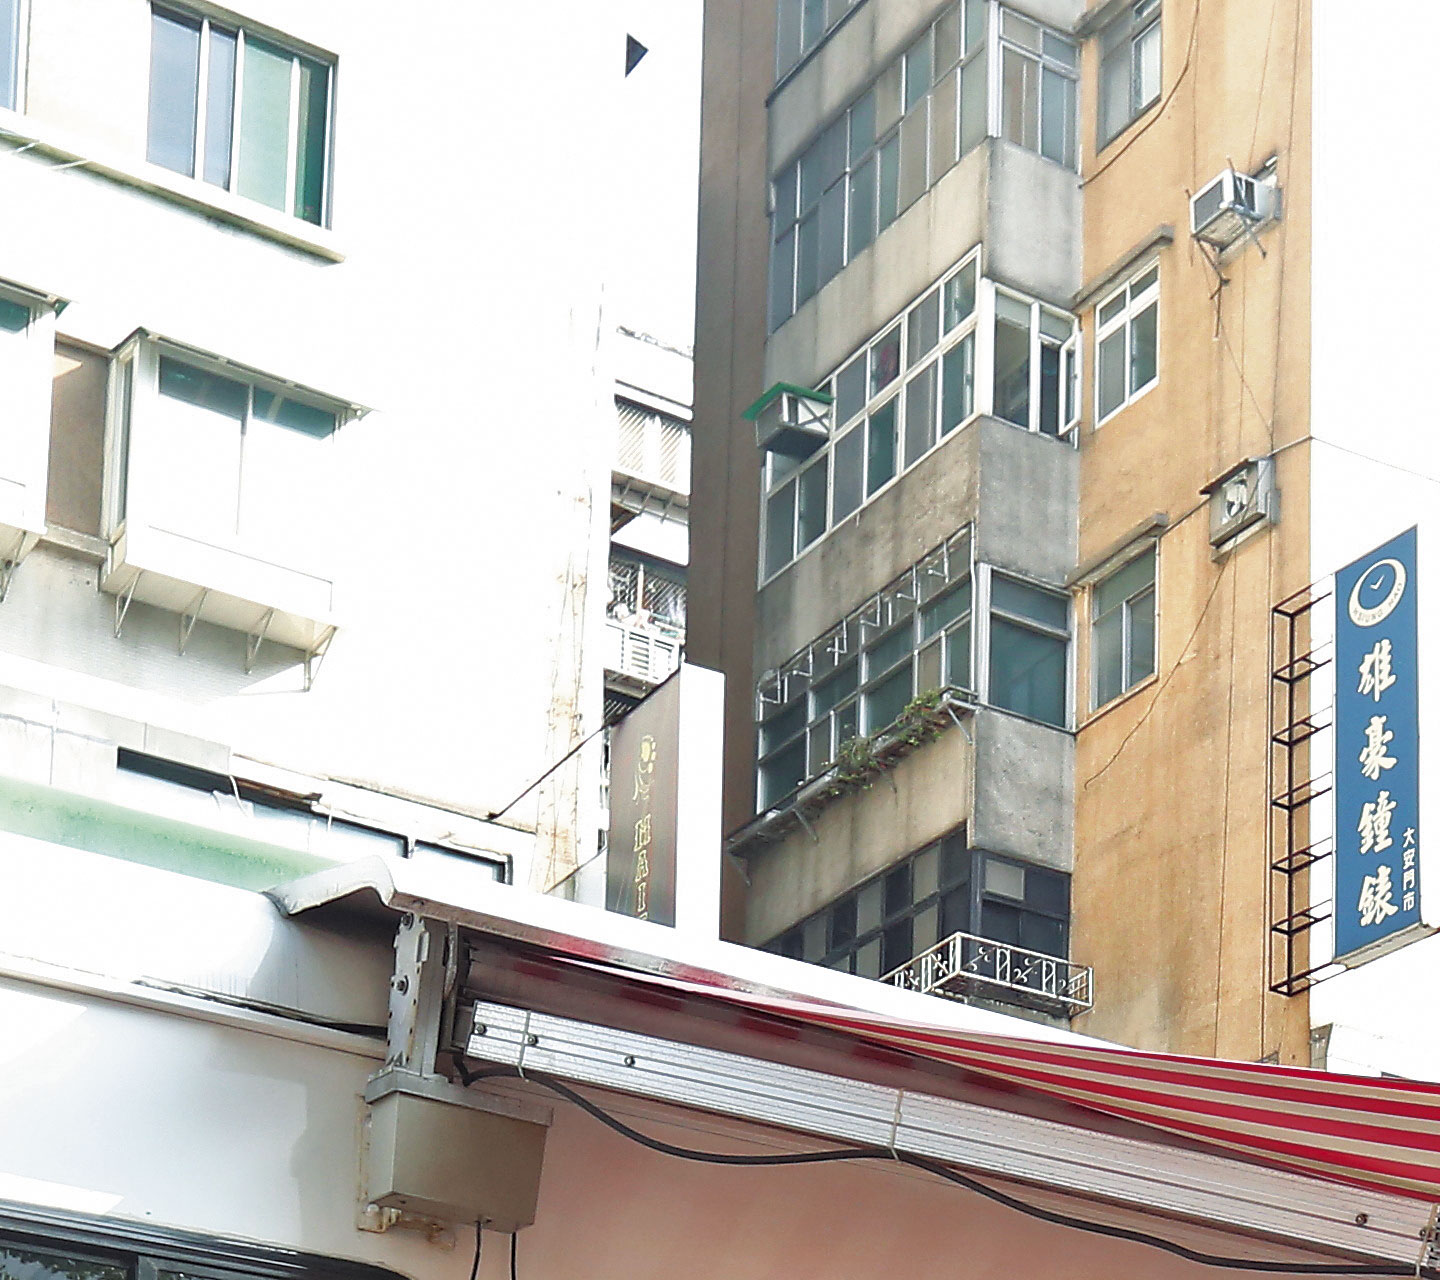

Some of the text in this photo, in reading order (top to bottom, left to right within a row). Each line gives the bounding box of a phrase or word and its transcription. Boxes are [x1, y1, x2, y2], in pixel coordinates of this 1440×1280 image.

[1357, 638, 1399, 927] 雄豪鐘錶
[1402, 827, 1416, 911] 大安門市
